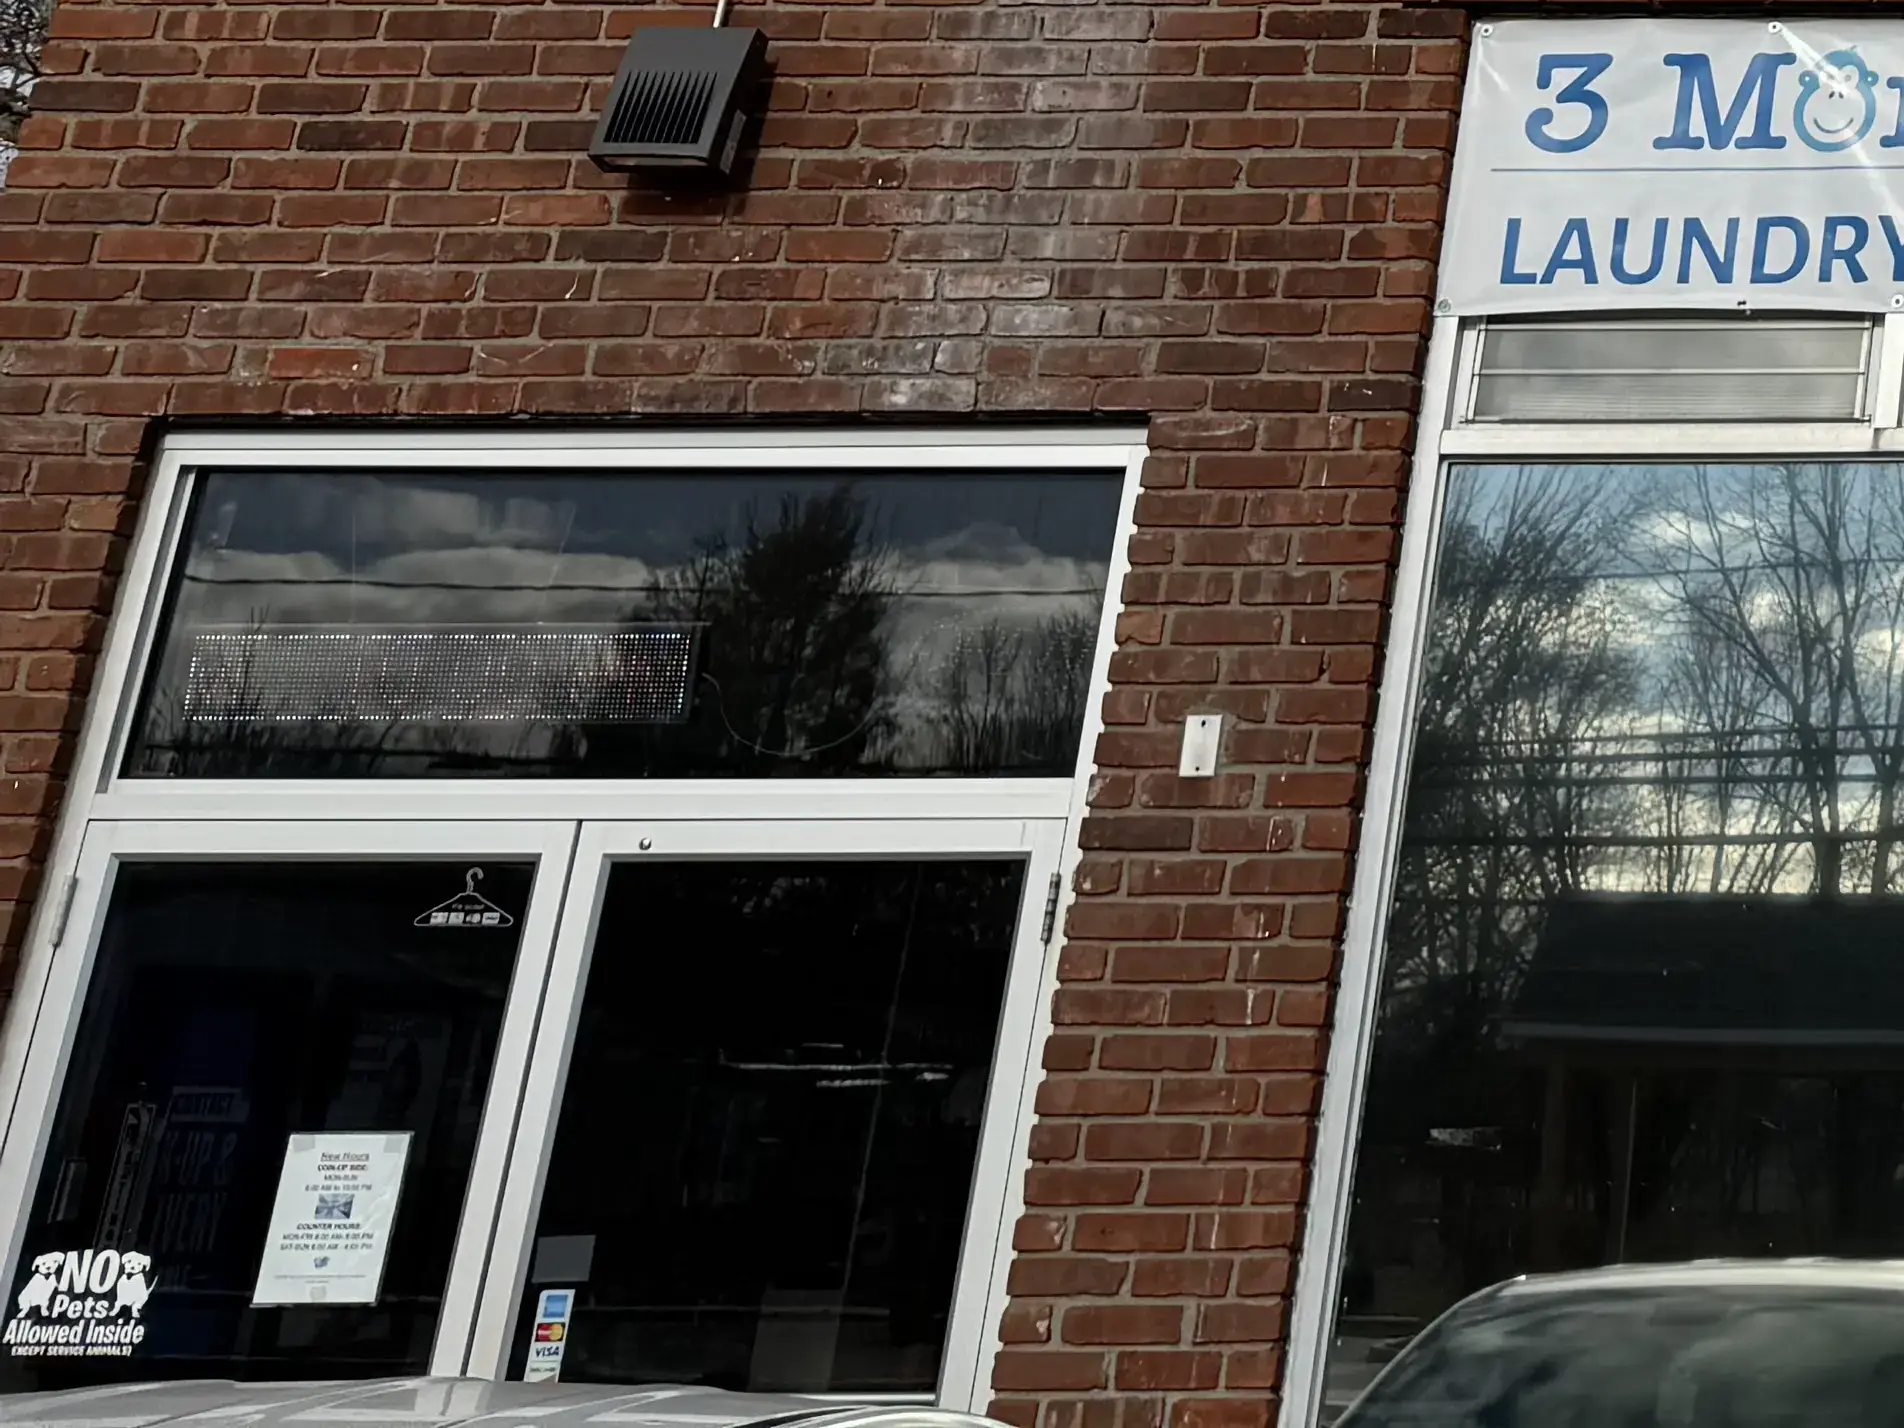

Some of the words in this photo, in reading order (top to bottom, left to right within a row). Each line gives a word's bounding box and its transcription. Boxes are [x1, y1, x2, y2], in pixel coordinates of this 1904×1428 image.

[1524, 52, 1614, 154] 3
[58, 1249, 120, 1294] NO
[51, 1294, 110, 1319] Pets
[2, 1319, 85, 1344] Allowed
[86, 1318, 145, 1344] Inside
[536, 1346, 560, 1357] VISA
